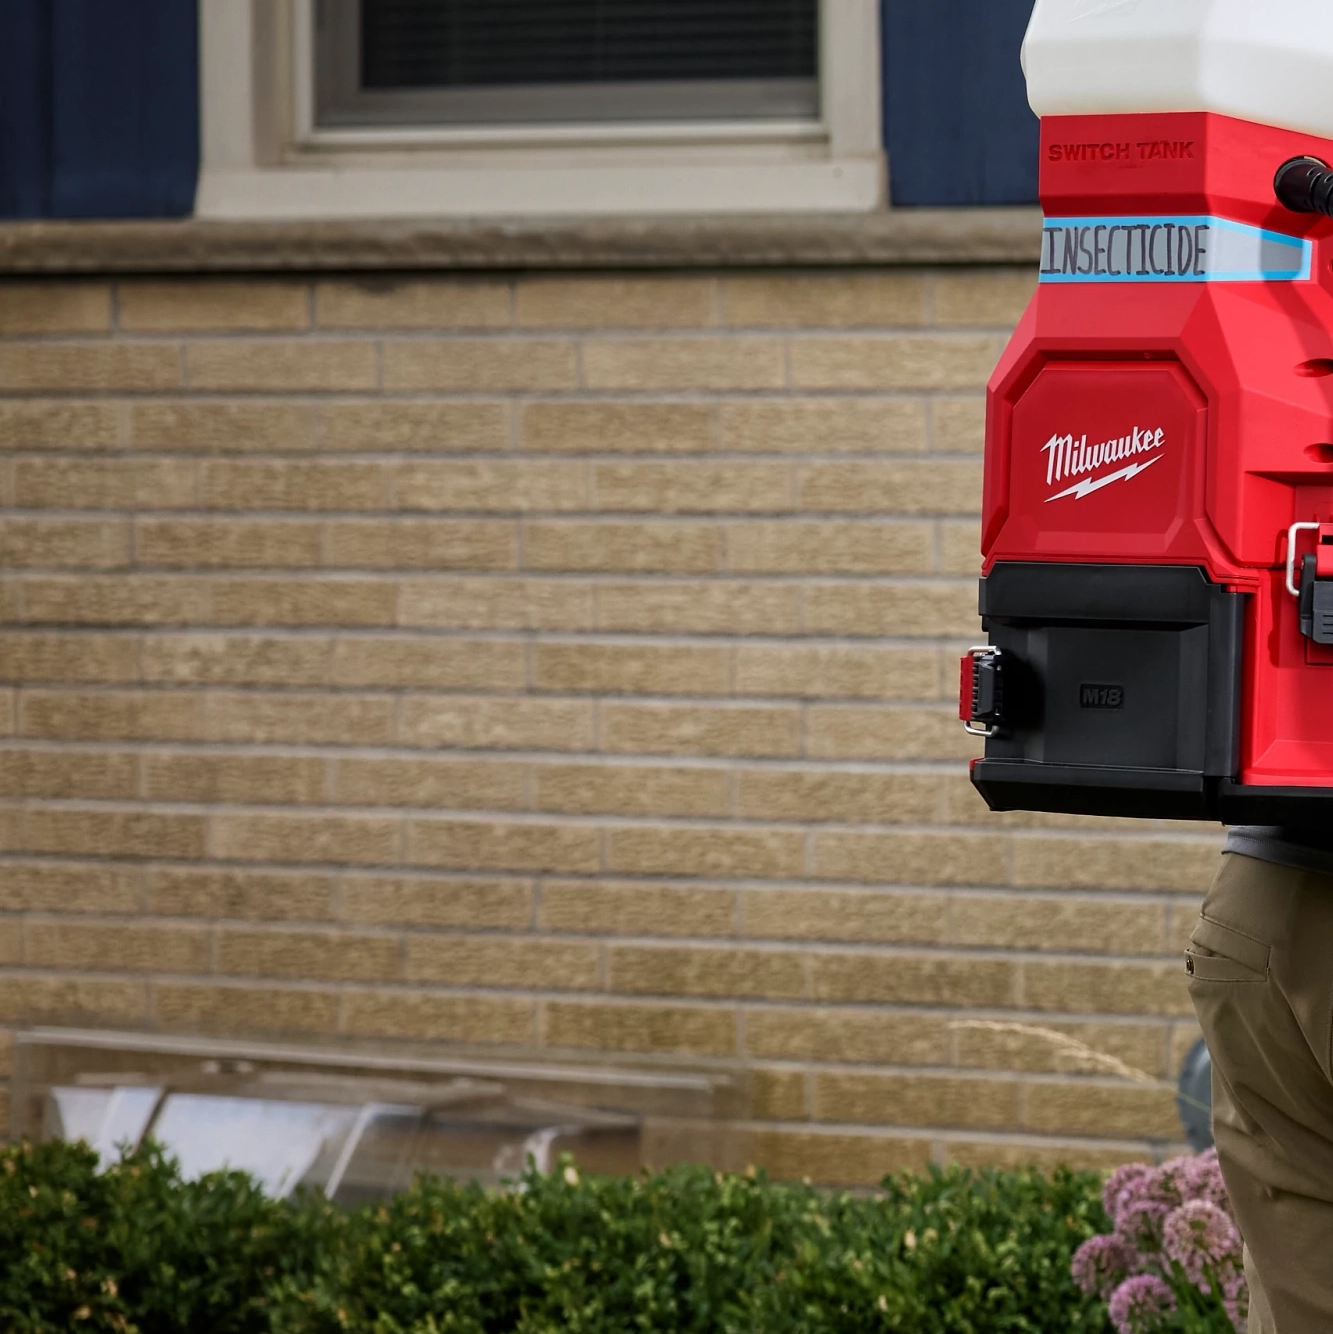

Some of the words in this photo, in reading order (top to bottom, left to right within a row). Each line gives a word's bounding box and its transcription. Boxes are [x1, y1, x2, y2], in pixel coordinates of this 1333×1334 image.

[1048, 142, 1131, 163] SWITCH
[1136, 141, 1195, 161] TANK
[1040, 223, 1210, 276] INSECTICIDE
[1040, 426, 1166, 486] Milwaukee
[1083, 688, 1121, 706] M18
